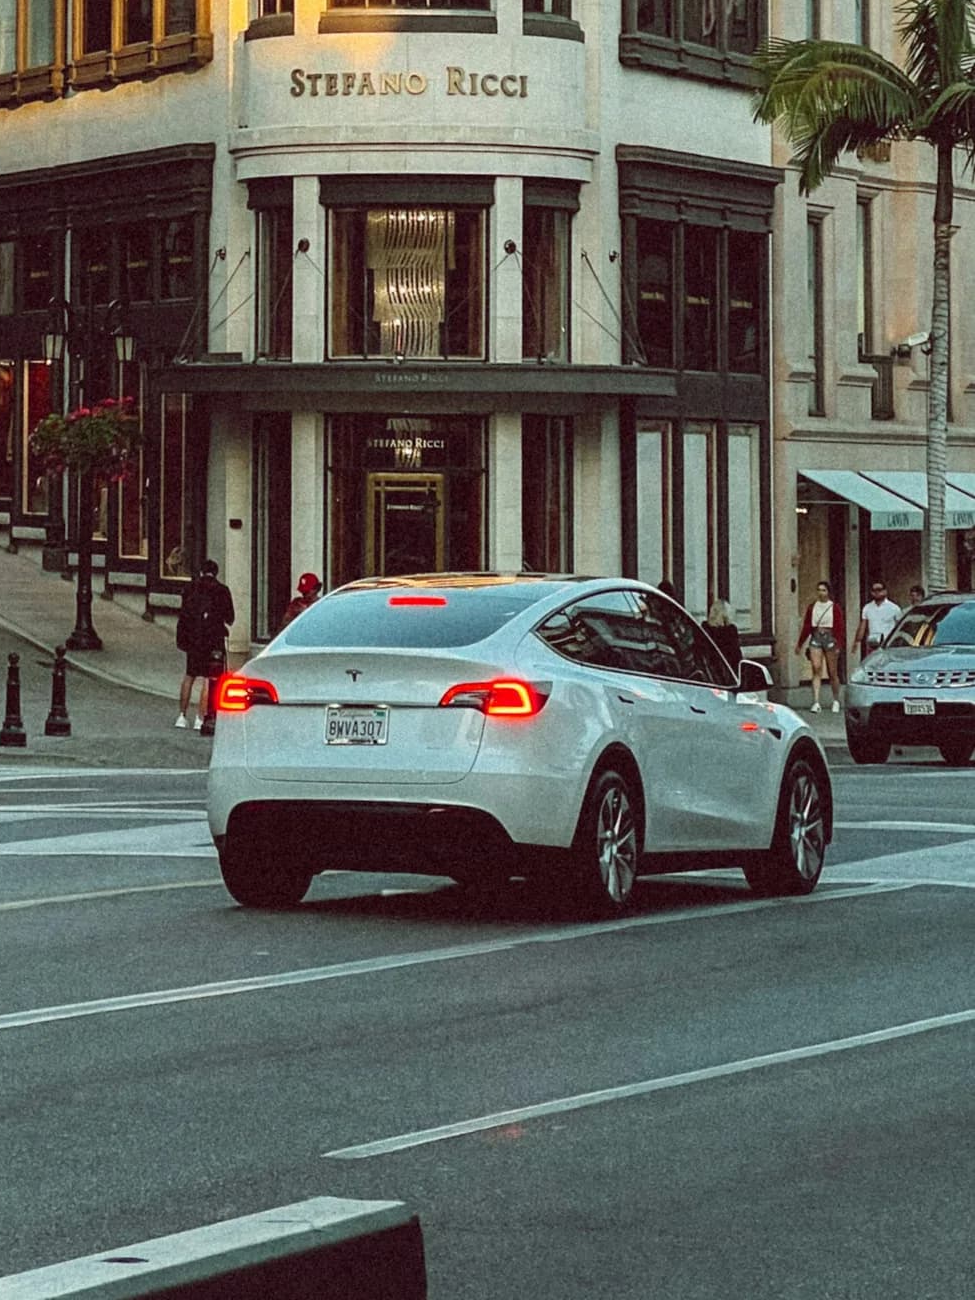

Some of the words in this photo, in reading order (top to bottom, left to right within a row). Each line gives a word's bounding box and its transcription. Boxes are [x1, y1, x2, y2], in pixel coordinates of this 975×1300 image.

[290, 68, 427, 97] STEFANO
[446, 66, 528, 98] RICCI
[414, 437, 444, 449] RICCI
[329, 720, 383, 737] 8WVA307
